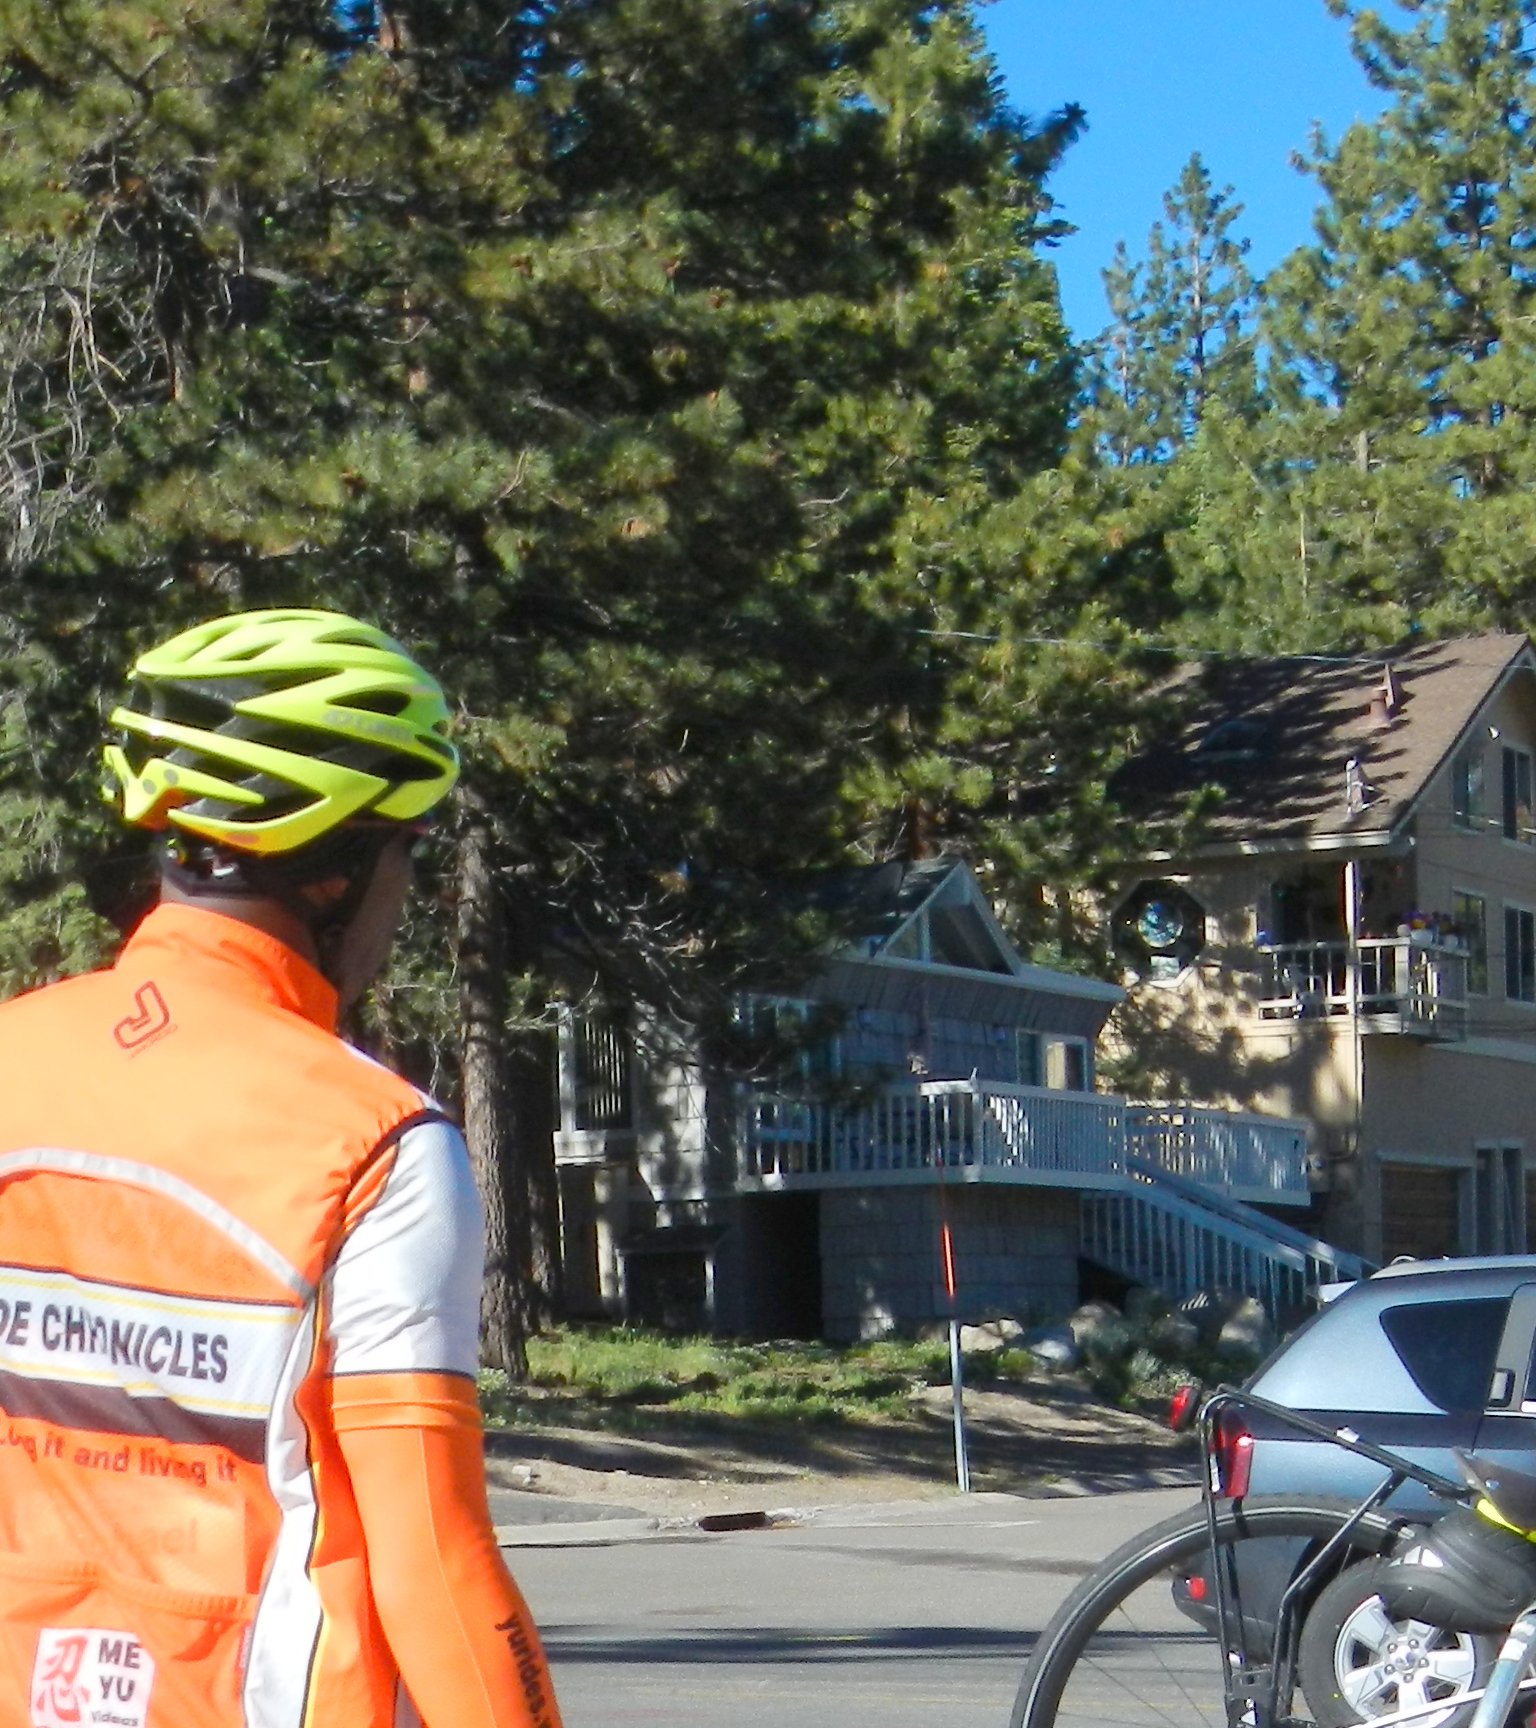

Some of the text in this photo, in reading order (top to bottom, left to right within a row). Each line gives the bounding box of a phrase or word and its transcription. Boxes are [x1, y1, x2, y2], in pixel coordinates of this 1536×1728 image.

[42, 1303, 229, 1383] CHNICLES
[74, 1445, 129, 1472] and
[216, 1454, 237, 1482] it
[98, 1638, 141, 1669] ME
[99, 1675, 135, 1702] YU
